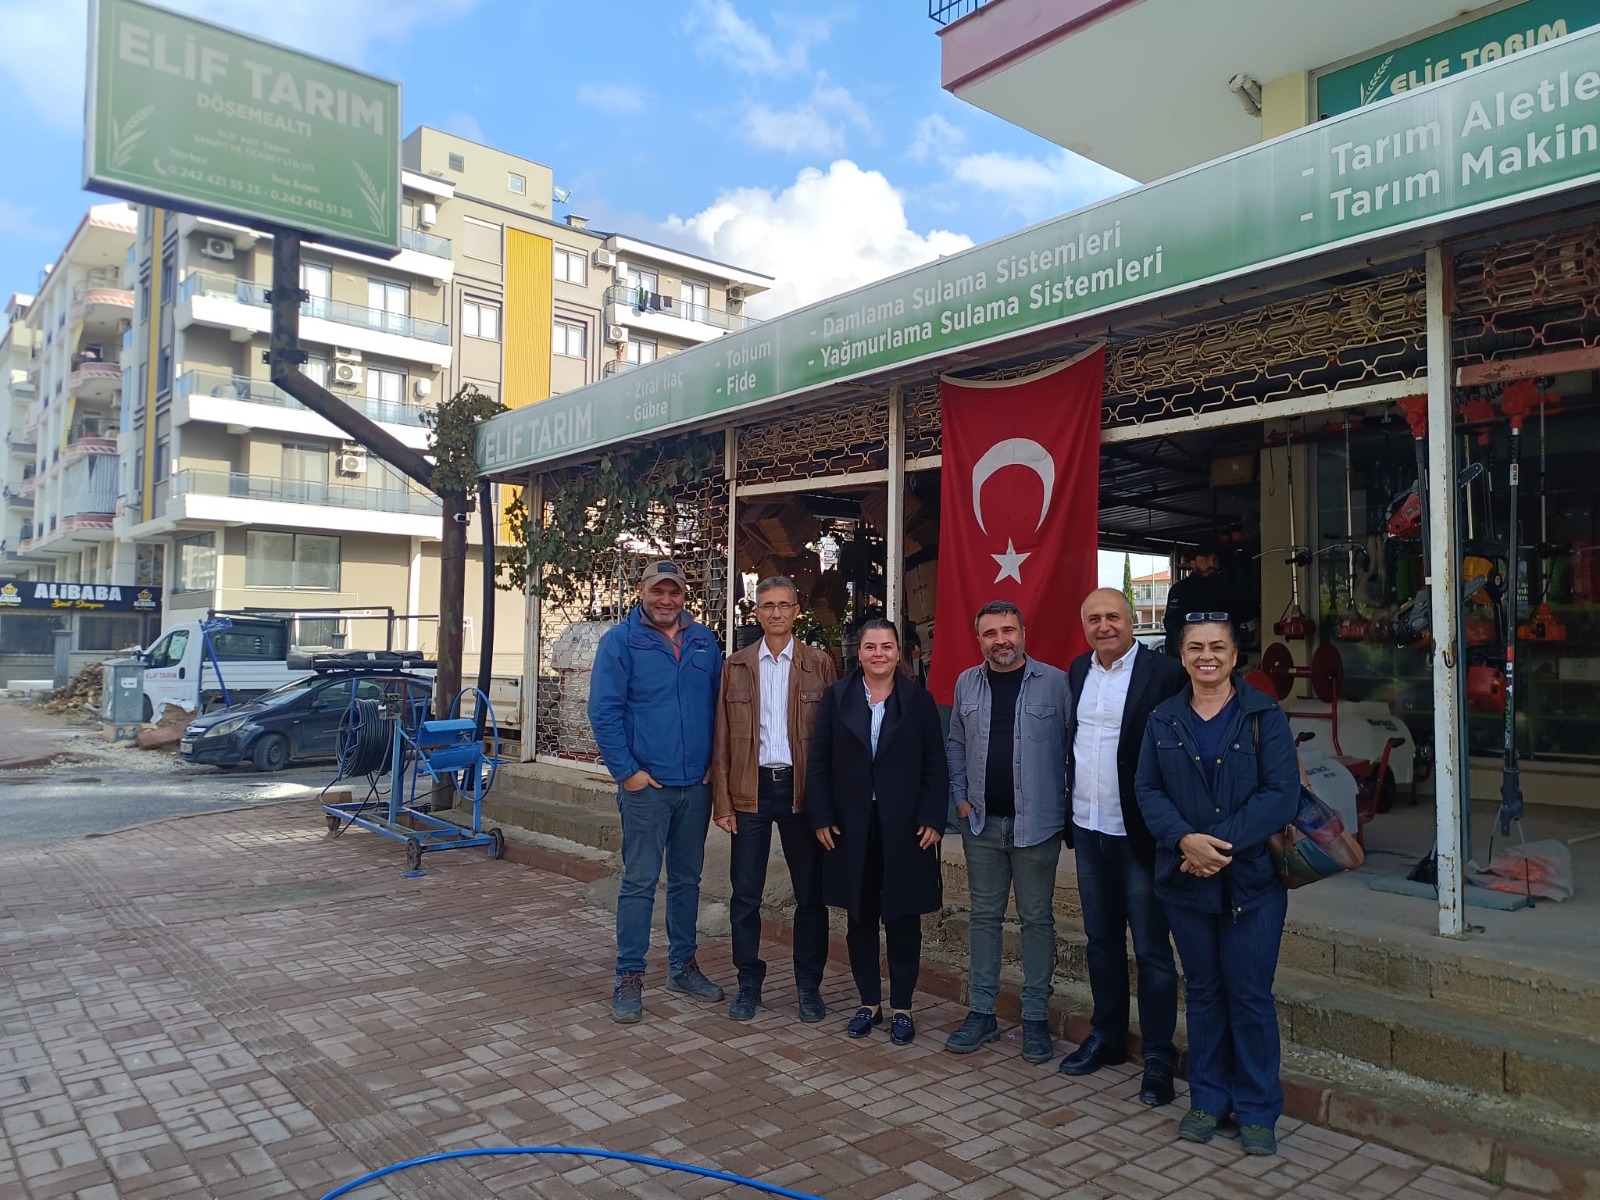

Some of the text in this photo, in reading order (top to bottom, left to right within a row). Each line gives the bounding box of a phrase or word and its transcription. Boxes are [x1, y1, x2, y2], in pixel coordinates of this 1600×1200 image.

[119, 21, 384, 136] ELİF TARIM
[197, 92, 311, 138] DÖŞEMEALTI
[1330, 119, 1442, 176] Tarım
[1330, 167, 1441, 221] Tarım
[1461, 123, 1598, 186] Makin
[820, 318, 932, 369] Yağmurlama
[940, 295, 1019, 336] Sulama
[1029, 245, 1163, 311] Sistemleri
[822, 297, 905, 339] Damlama
[912, 270, 987, 312] Sulama
[996, 219, 1122, 284] Sistemleri
[725, 340, 772, 370] Tohum
[727, 370, 757, 396] Fide
[634, 378, 659, 398] Zirai
[634, 401, 668, 422] Gübre
[484, 402, 593, 466] ELİF TARIM
